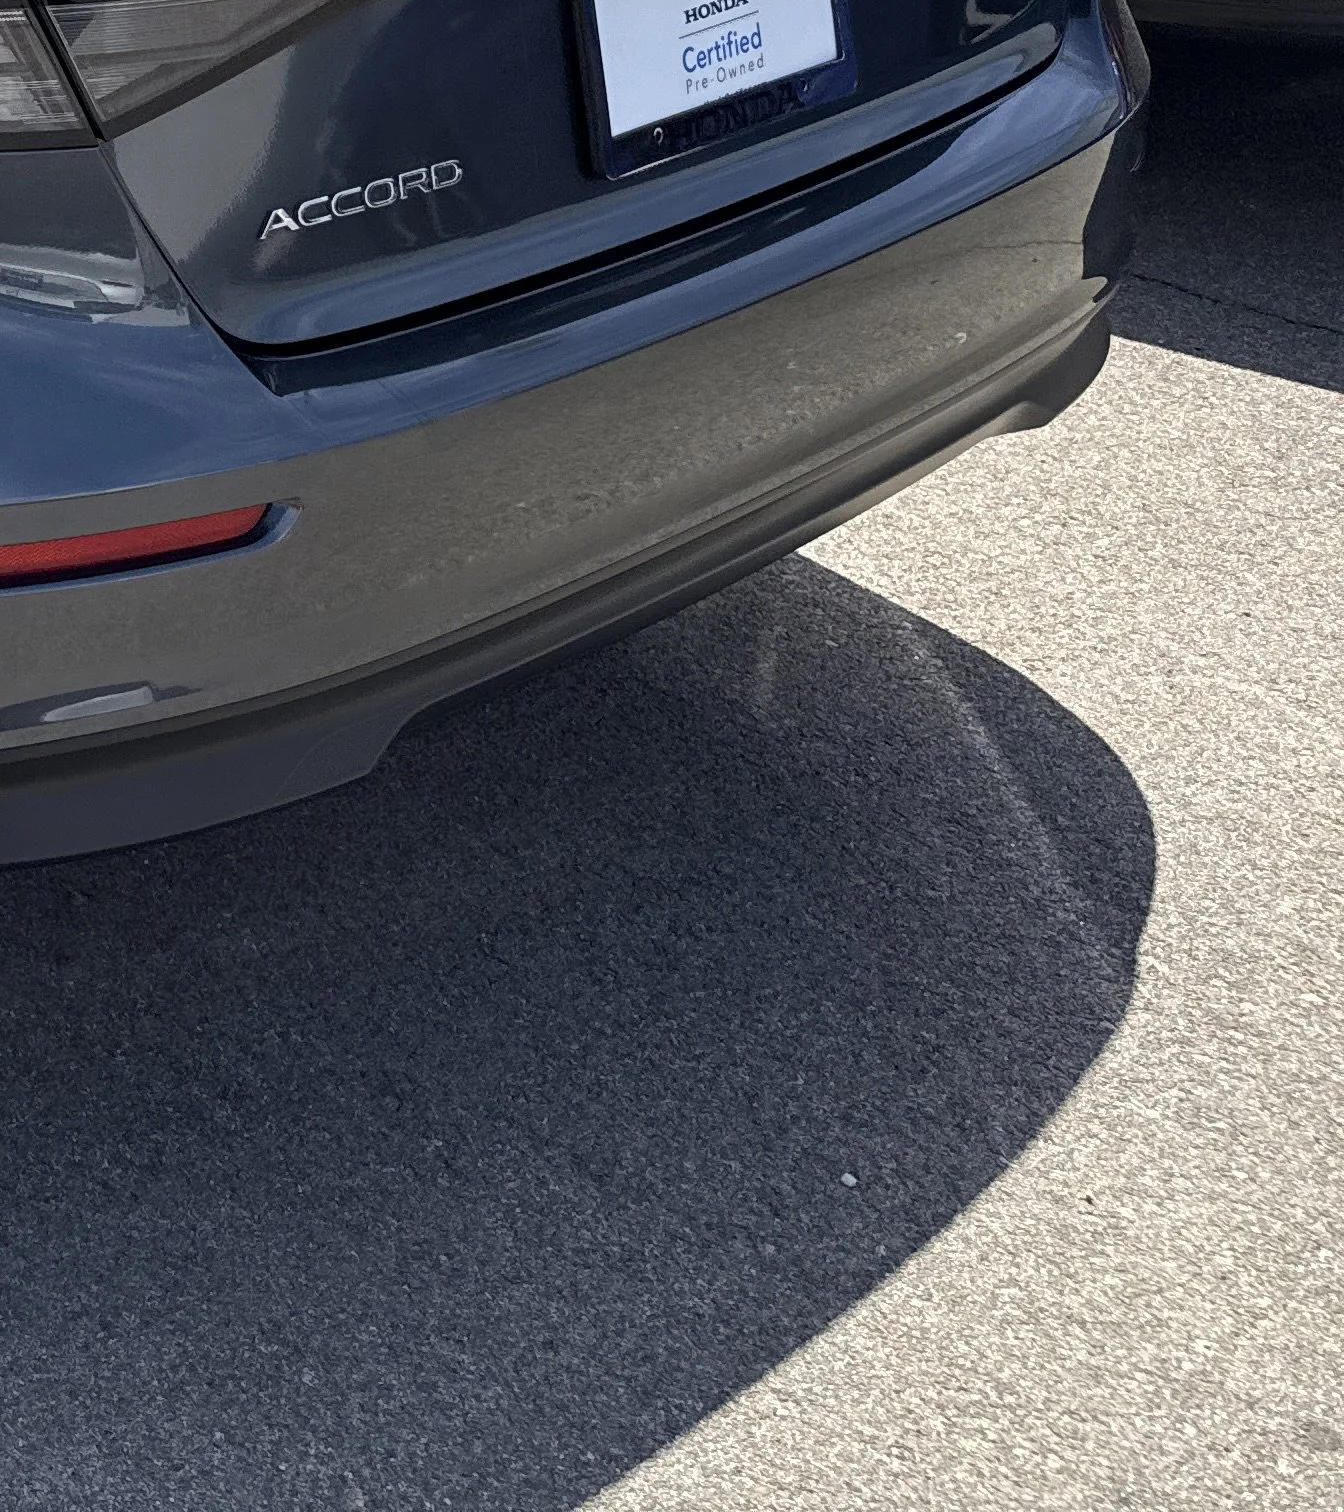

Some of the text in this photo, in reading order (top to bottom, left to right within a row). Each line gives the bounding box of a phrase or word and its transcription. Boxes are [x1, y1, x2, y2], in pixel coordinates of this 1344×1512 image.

[681, 21, 763, 73] Certified
[685, 55, 765, 95] Pre-Owned
[259, 158, 464, 240] ACCORD
